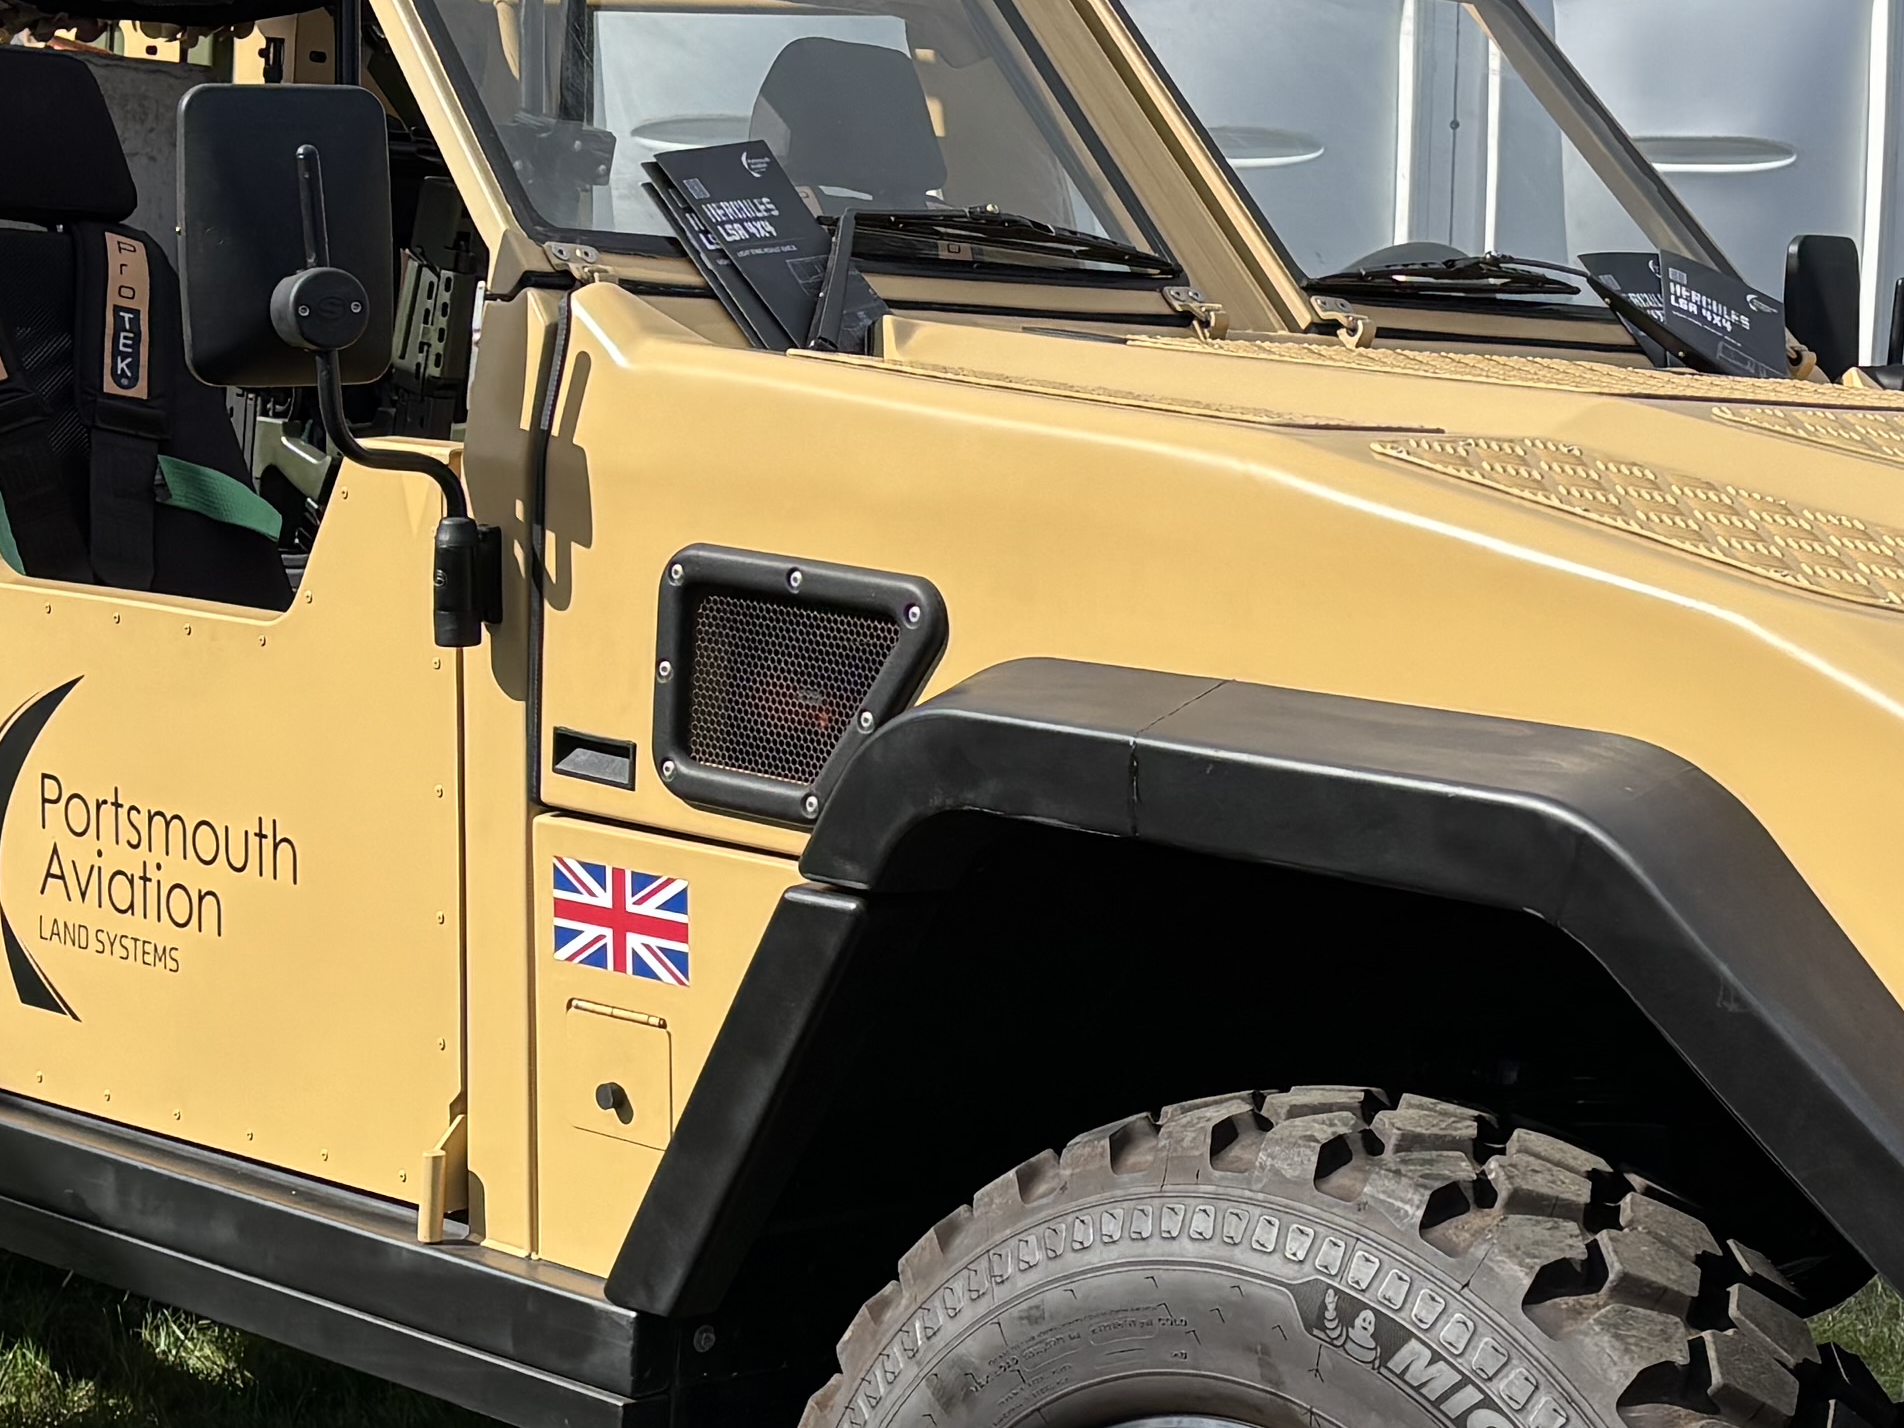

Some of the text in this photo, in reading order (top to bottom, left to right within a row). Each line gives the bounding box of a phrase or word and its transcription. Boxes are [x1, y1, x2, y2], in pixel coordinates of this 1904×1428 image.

[701, 197, 779, 223] HERCULES
[1669, 282, 1751, 330] HERCULES
[40, 772, 299, 886] Portsmouth
[40, 841, 222, 937] Aviation
[38, 914, 180, 973] LAND SYSTEMS
